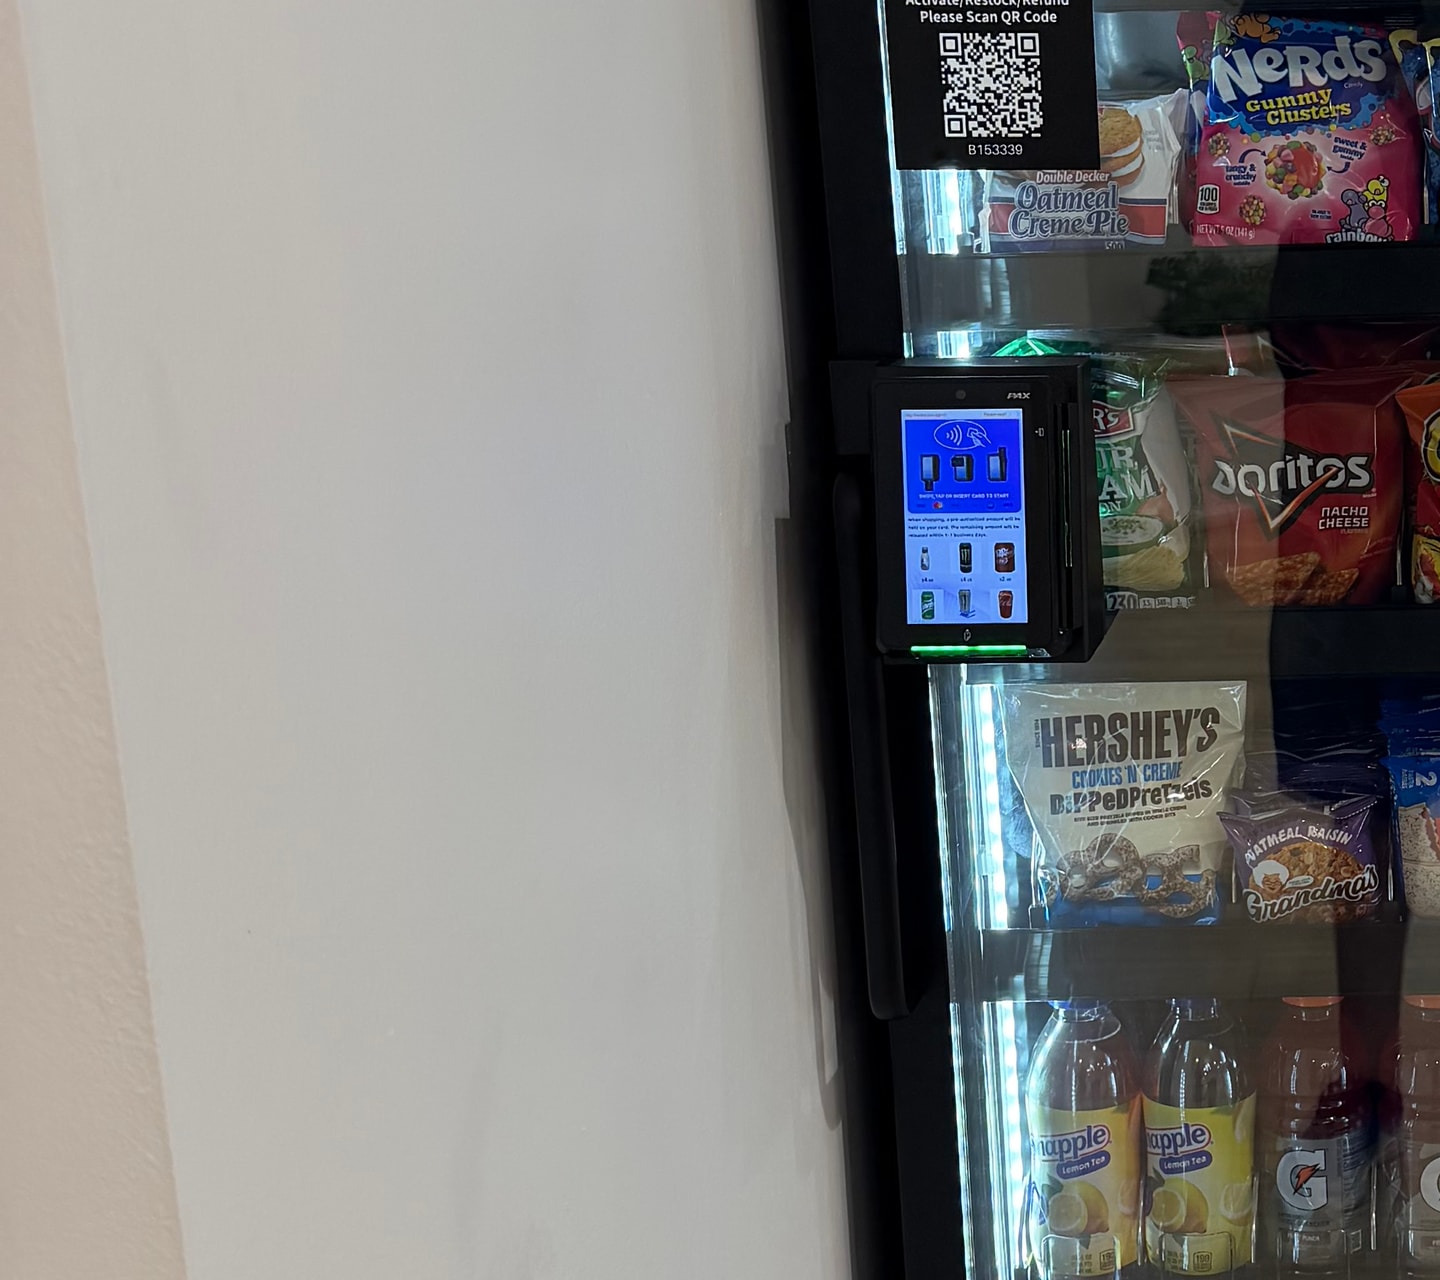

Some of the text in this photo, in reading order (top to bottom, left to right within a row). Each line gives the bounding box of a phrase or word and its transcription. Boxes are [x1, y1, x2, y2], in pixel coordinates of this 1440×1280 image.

[919, 10, 1058, 25] Please Scan QR Code
[1245, 88, 1333, 112] Gummy
[1266, 102, 1352, 126] Clusters
[967, 144, 1024, 157] B153339
[1332, 144, 1365, 160] gummy
[1036, 170, 1110, 184] Double Decker
[1016, 182, 1119, 212] Oatmeal
[1199, 187, 1218, 202] 100
[1010, 210, 1129, 237] Creme Pie
[1212, 453, 1374, 497] Doritos
[1321, 505, 1369, 517] NACHO
[1318, 517, 1370, 530] CHEESE
[1040, 706, 1221, 769] HERSHEY'S
[1071, 766, 1123, 790] COOKIES
[1142, 761, 1184, 782] CREME
[1415, 771, 1438, 788] 2
[1244, 825, 1354, 866] OATMEAL RAISIN
[1243, 863, 1380, 923] Grandma's
[1061, 1155, 1107, 1175] Lemon Tea
[1163, 1154, 1208, 1170] Lemon Tea
[1276, 1149, 1328, 1211] G
